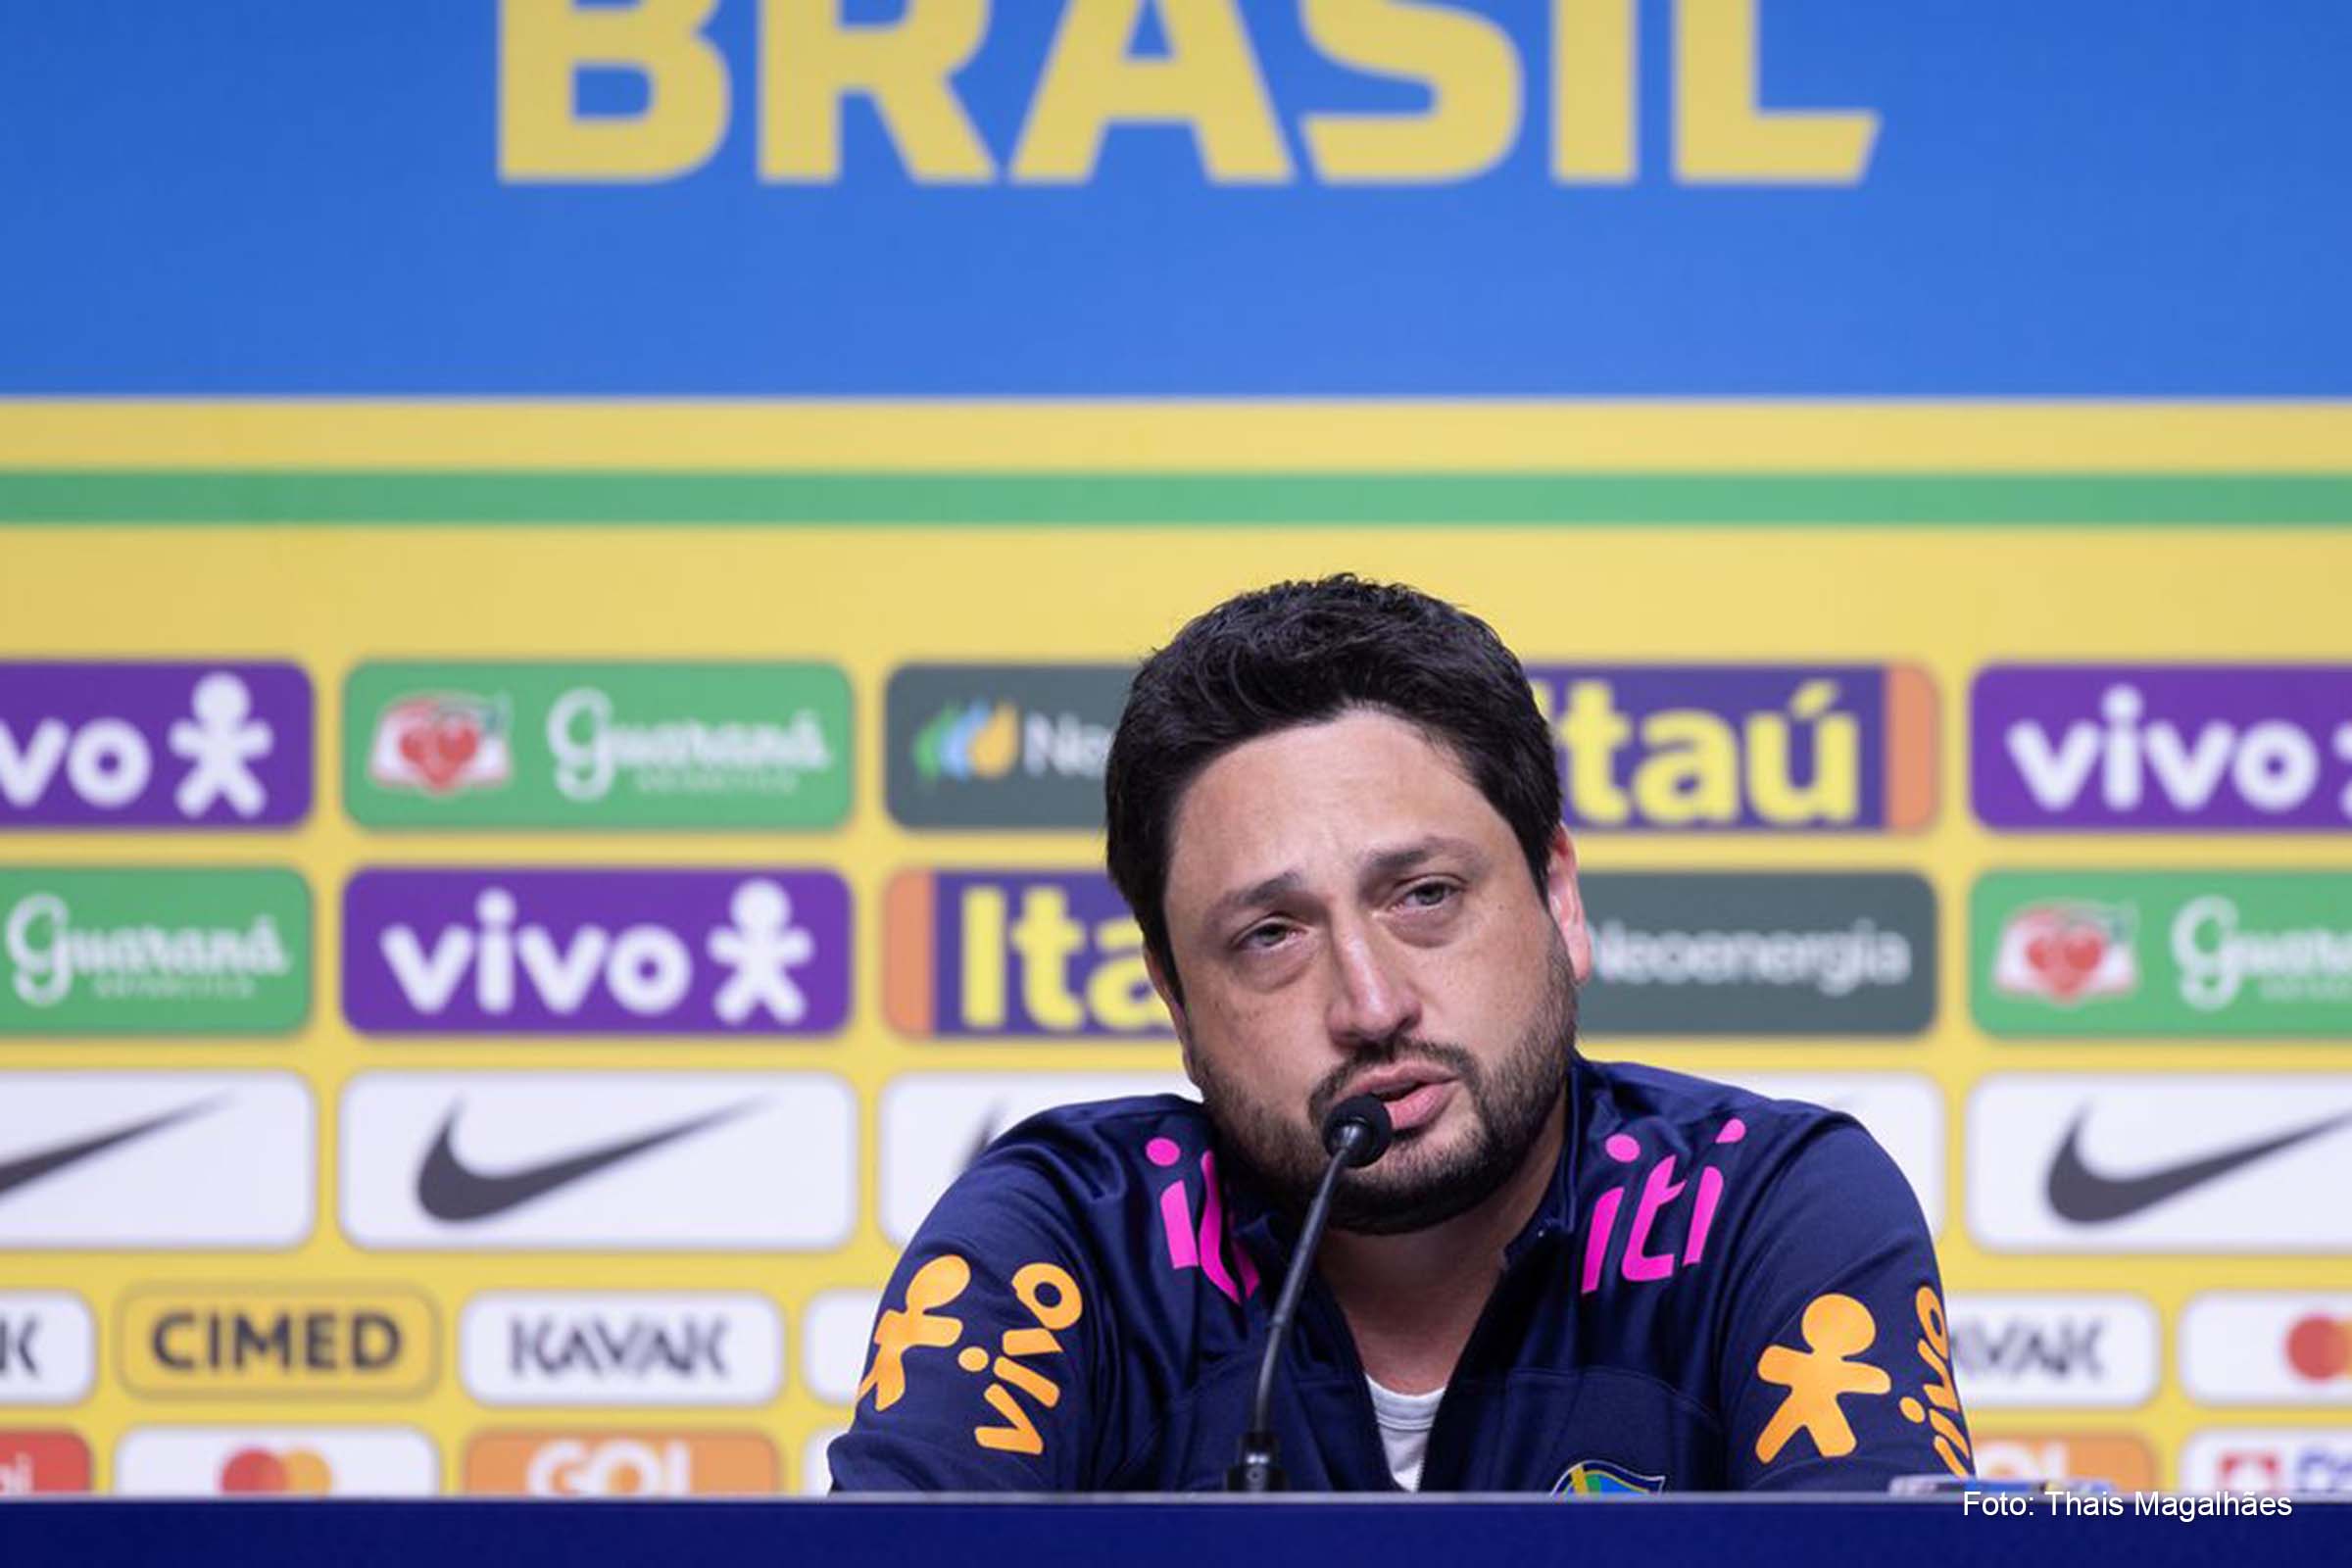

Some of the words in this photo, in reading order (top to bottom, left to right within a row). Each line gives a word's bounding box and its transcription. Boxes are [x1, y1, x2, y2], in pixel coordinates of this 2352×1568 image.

[498, 0, 1881, 186] BRASIL
[2006, 685, 2318, 812] vivo
[380, 888, 693, 1015] vivo
[1581, 1117, 1747, 1295] iti
[151, 1312, 403, 1372] CIMED
[508, 1316, 729, 1379] KAVAK
[958, 1262, 1083, 1455] vivo
